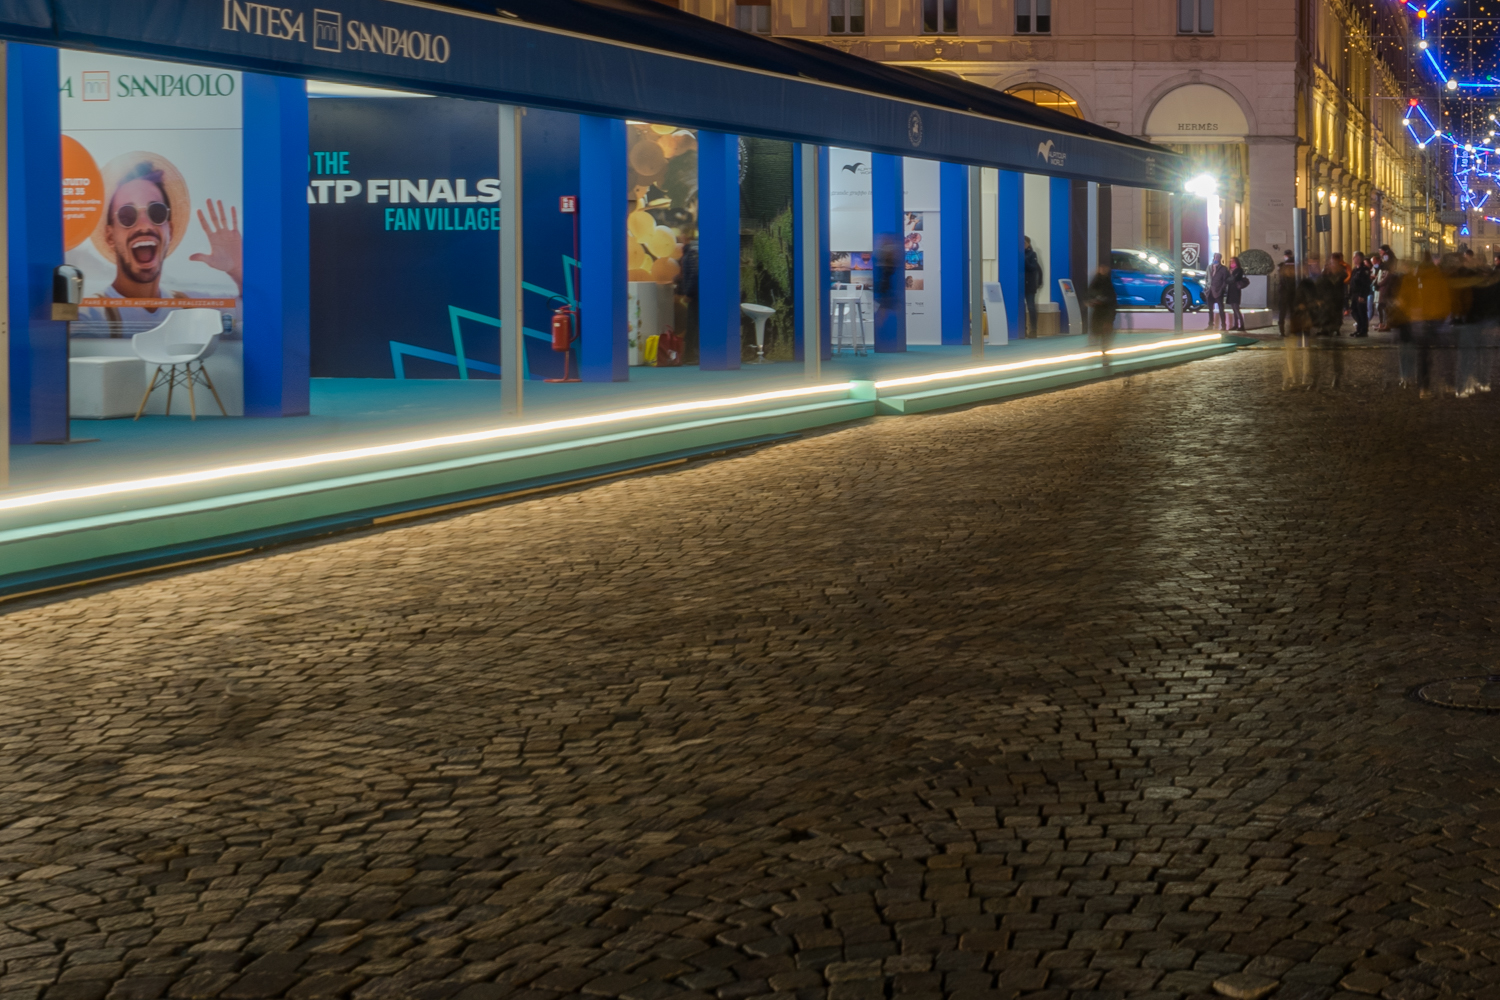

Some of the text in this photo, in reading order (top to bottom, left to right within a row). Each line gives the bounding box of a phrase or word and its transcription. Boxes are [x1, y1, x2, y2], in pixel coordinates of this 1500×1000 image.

[346, 20, 450, 63] SANPAOLO
[117, 73, 235, 97] SANPAOLO
[313, 151, 350, 175] THE
[367, 178, 502, 204] FINALS
[384, 207, 501, 231] FAN VILLAGE
